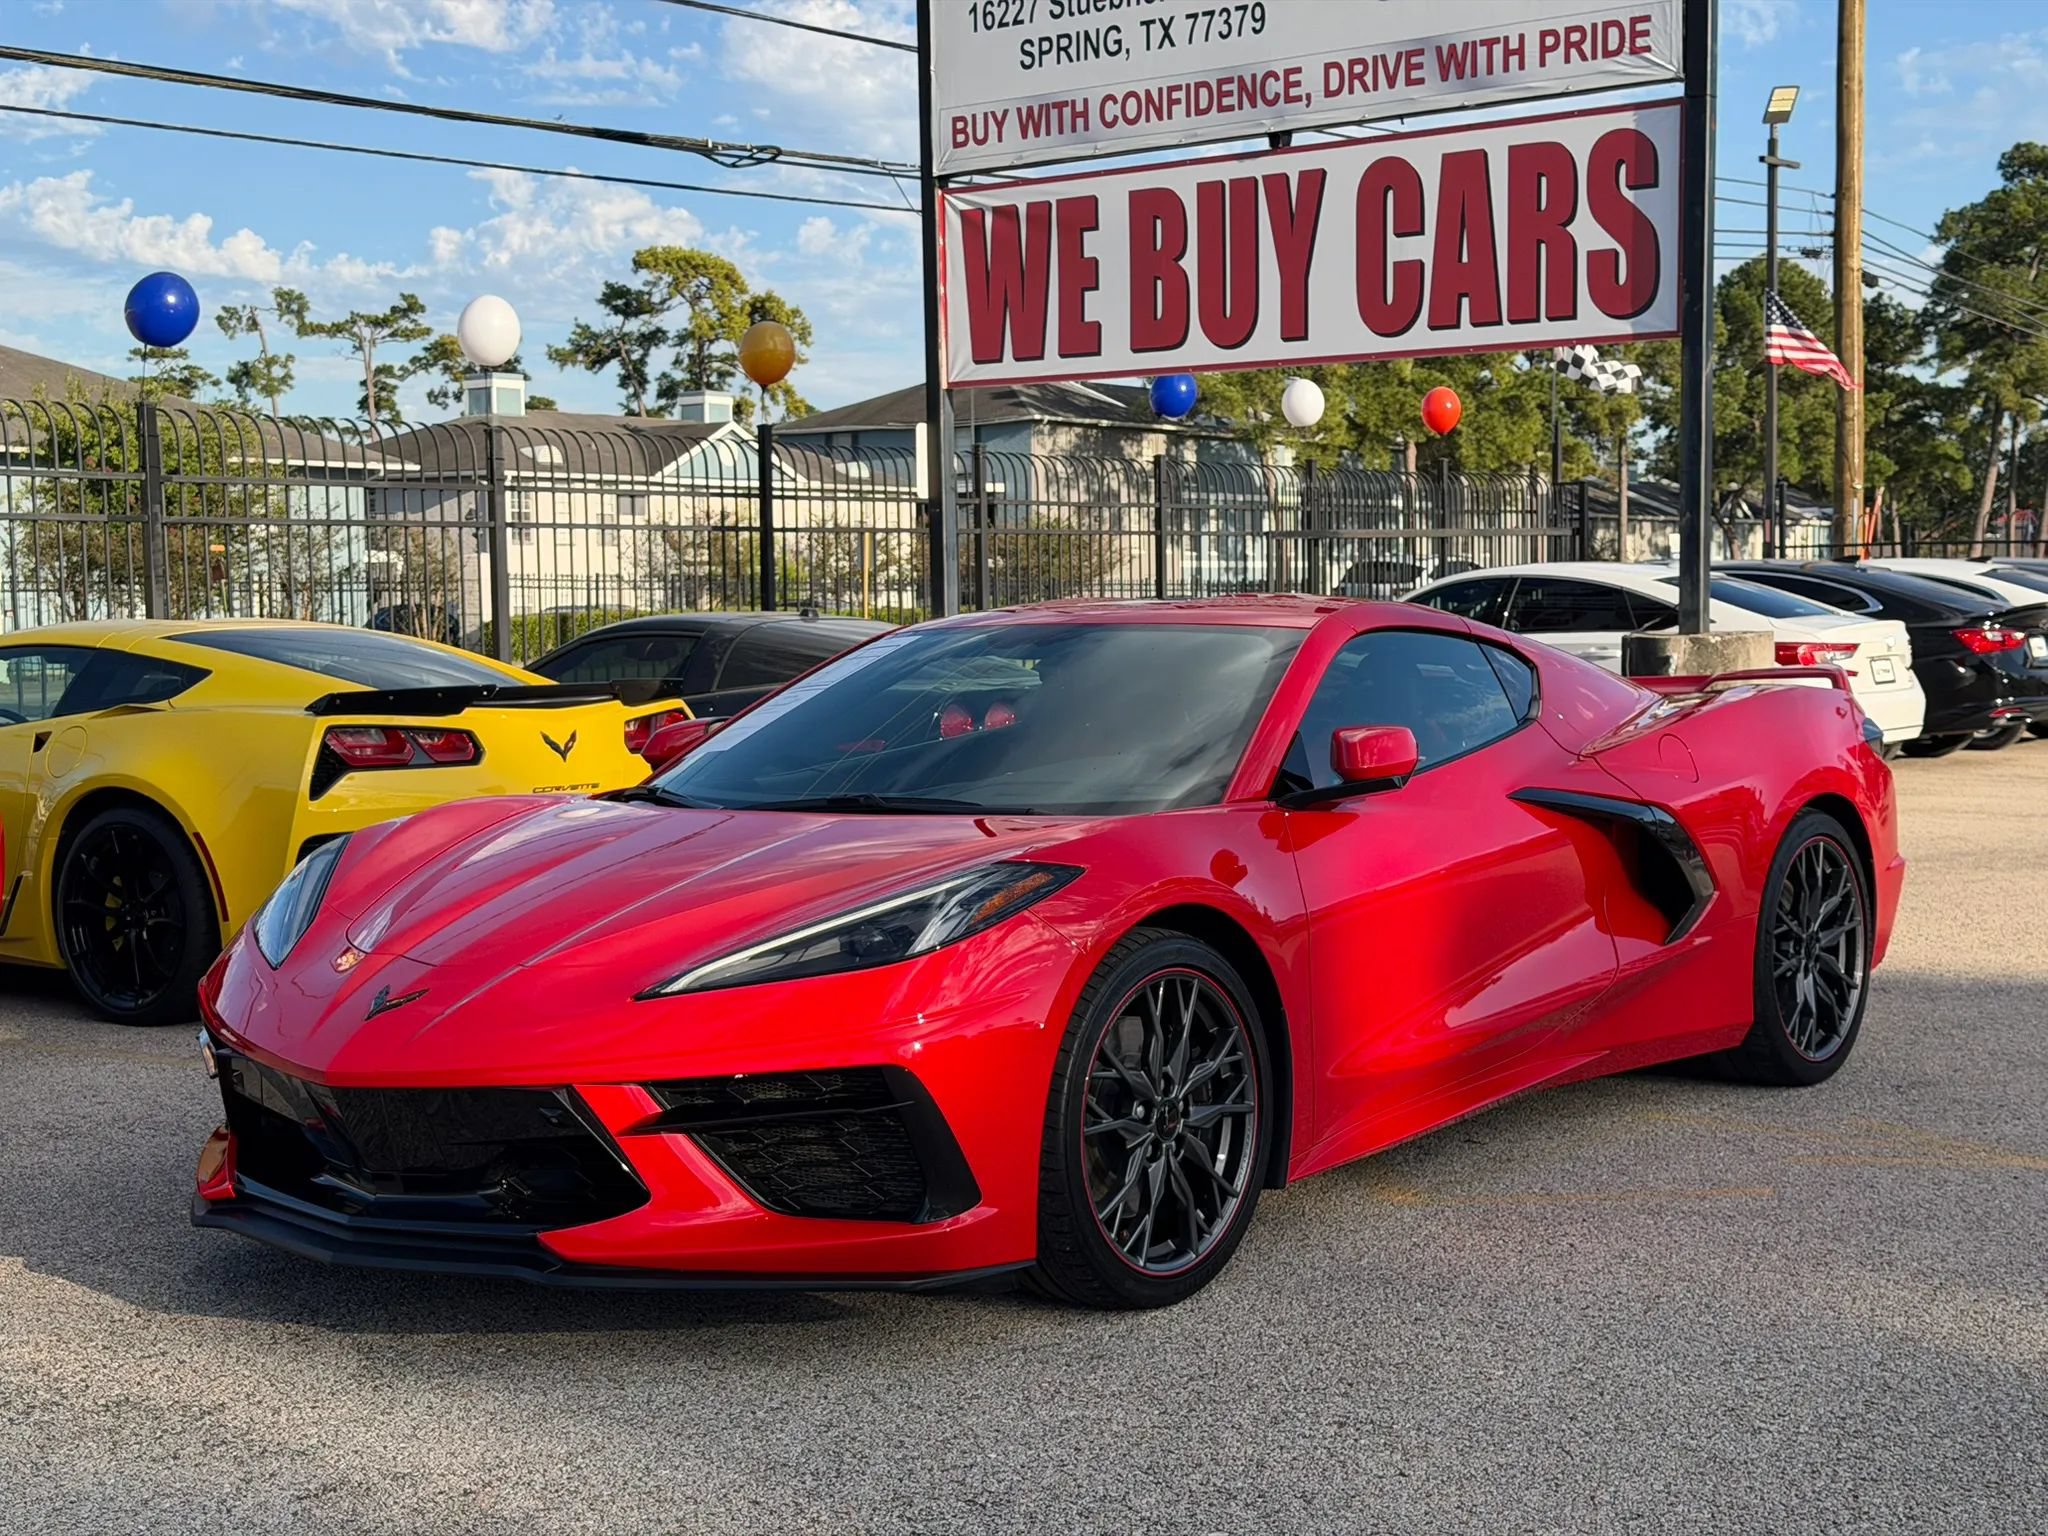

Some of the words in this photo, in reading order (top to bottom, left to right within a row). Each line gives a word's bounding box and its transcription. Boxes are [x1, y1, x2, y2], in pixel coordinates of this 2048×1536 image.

[968, 0, 1038, 33] 16227
[1019, 24, 1131, 71] SPRING,
[1139, 15, 1177, 52] TX
[1184, 1, 1267, 46] 77379
[951, 108, 1010, 150] BUY
[1016, 97, 1090, 140] WITH
[1098, 66, 1312, 130] CONFIDENCE,
[1323, 48, 1426, 99] DRIVE
[1435, 33, 1527, 82] WITH
[1538, 14, 1652, 68] PRIDE
[961, 193, 1102, 365] WE
[1128, 167, 1328, 353] BUY
[1356, 127, 1661, 338] CARS
